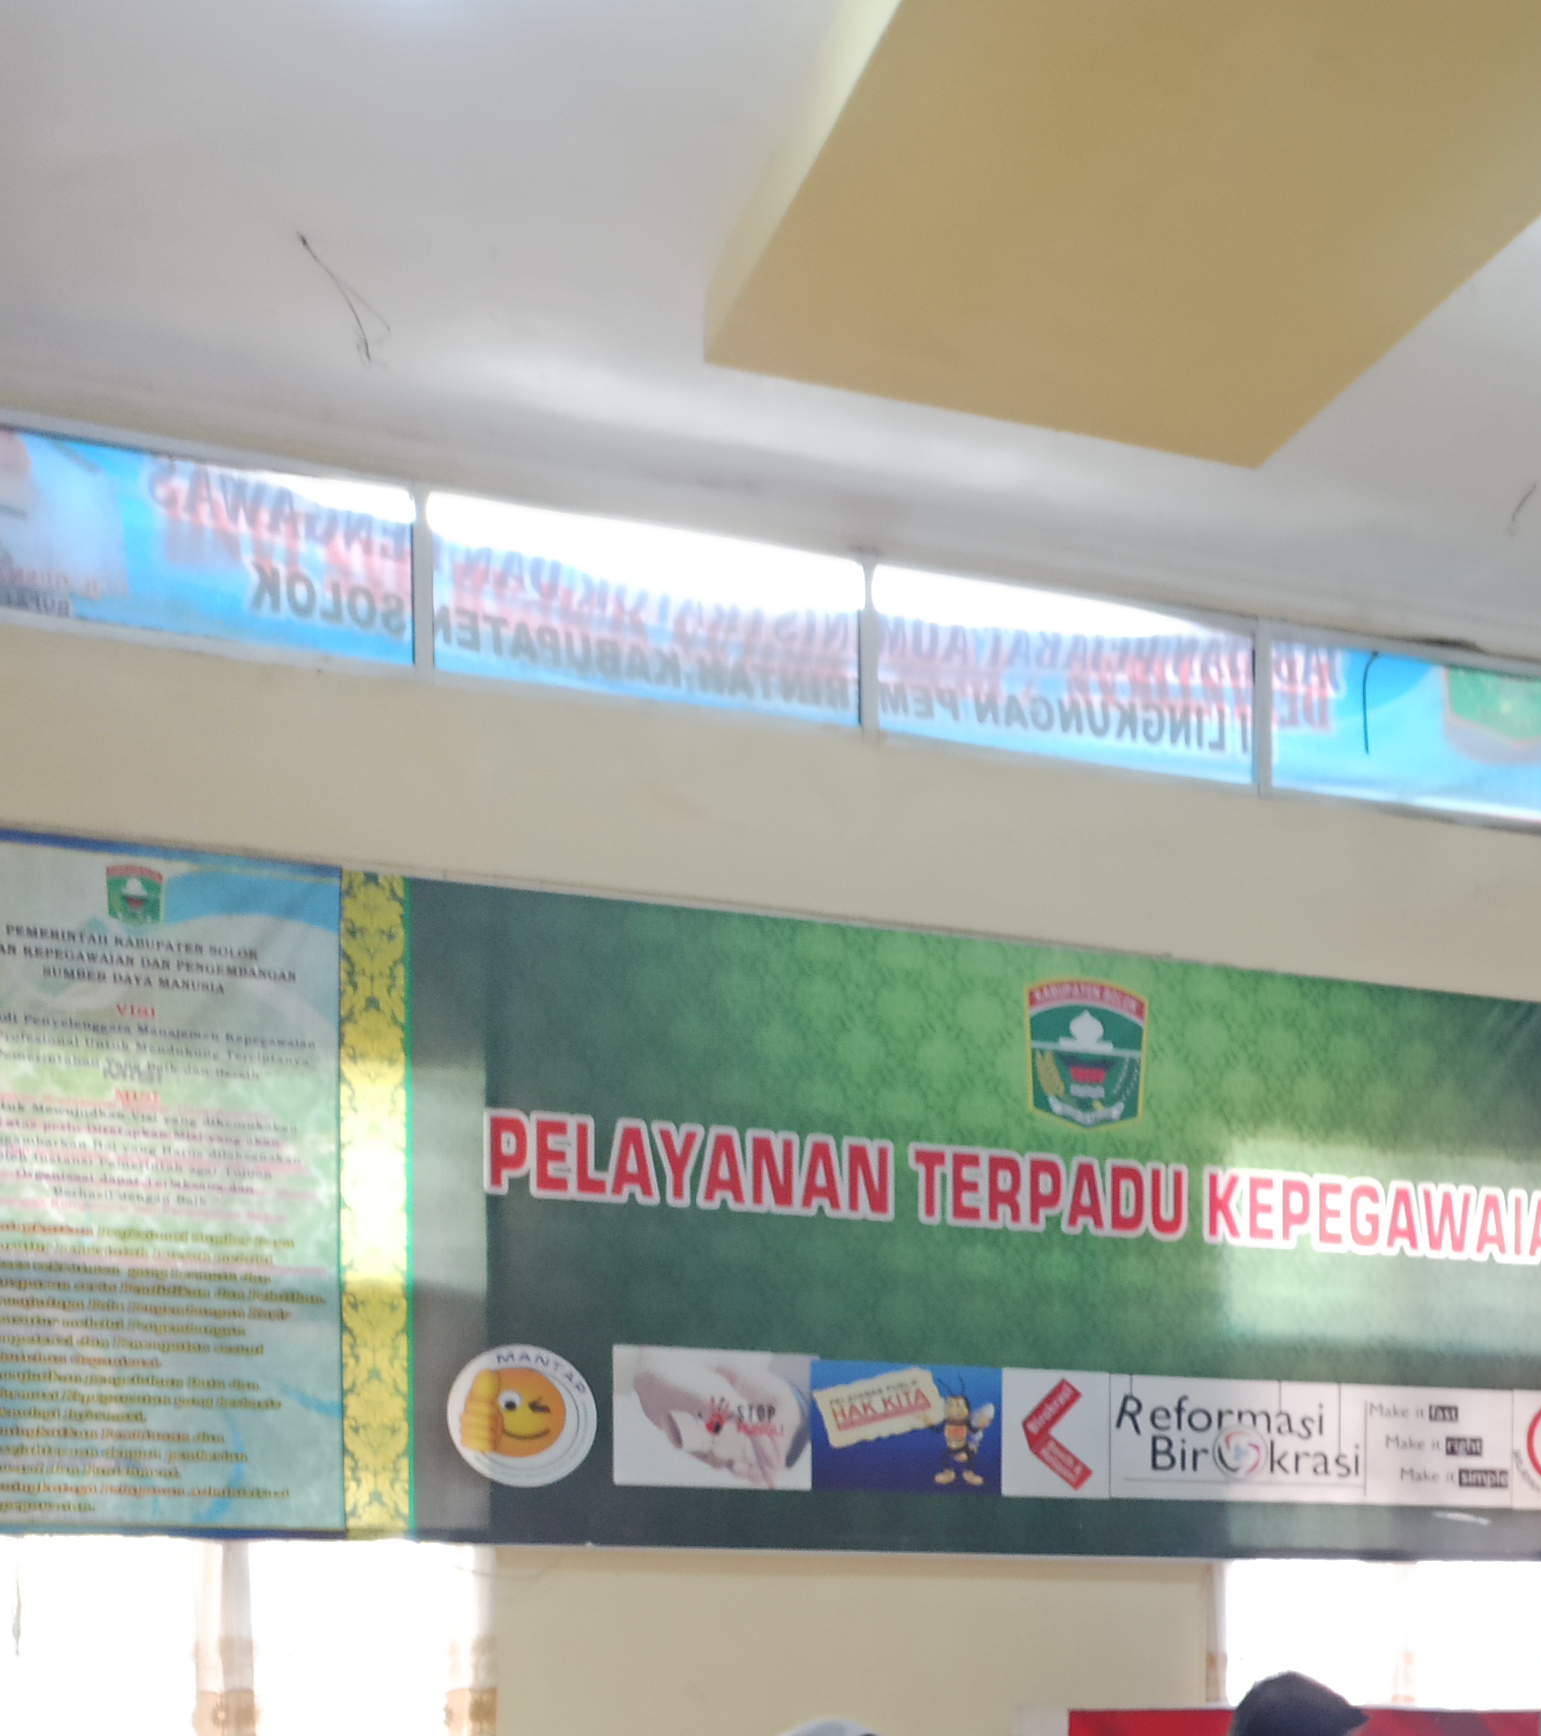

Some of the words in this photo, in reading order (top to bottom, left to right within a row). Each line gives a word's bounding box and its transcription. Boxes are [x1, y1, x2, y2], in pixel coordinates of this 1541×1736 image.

[486, 1111, 893, 1219] PELAYANAN
[911, 1144, 1188, 1239] TERPADU
[496, 1351, 588, 1394] MANTAP
[736, 1403, 776, 1423] STOP
[1116, 1394, 1324, 1440] Reformasi
[1369, 1402, 1409, 1417] Make
[1385, 1434, 1425, 1450] Make
[1400, 1467, 1440, 1482] Make
